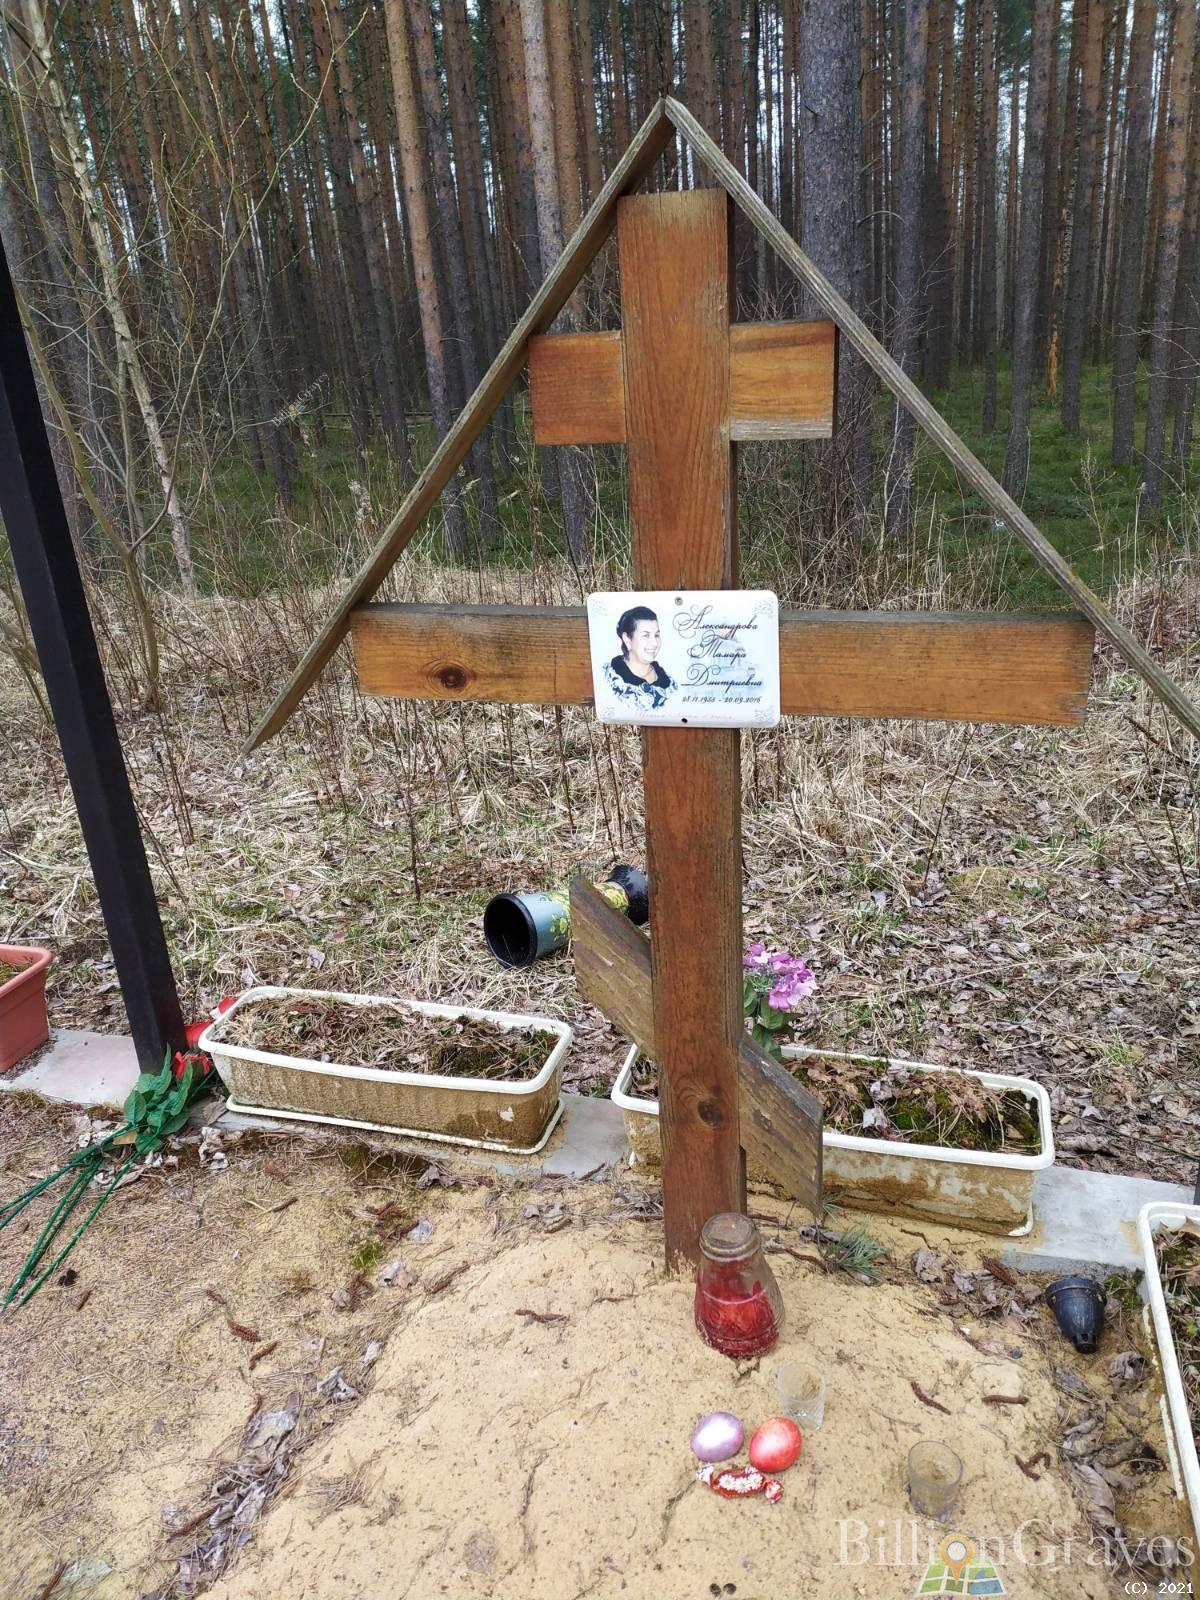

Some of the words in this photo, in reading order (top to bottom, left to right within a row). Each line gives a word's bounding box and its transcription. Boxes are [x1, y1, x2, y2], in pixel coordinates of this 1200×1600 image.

[672, 605, 758, 640] Александрова
[687, 630, 746, 665] Тамара
[680, 663, 763, 693] Дмитриевна
